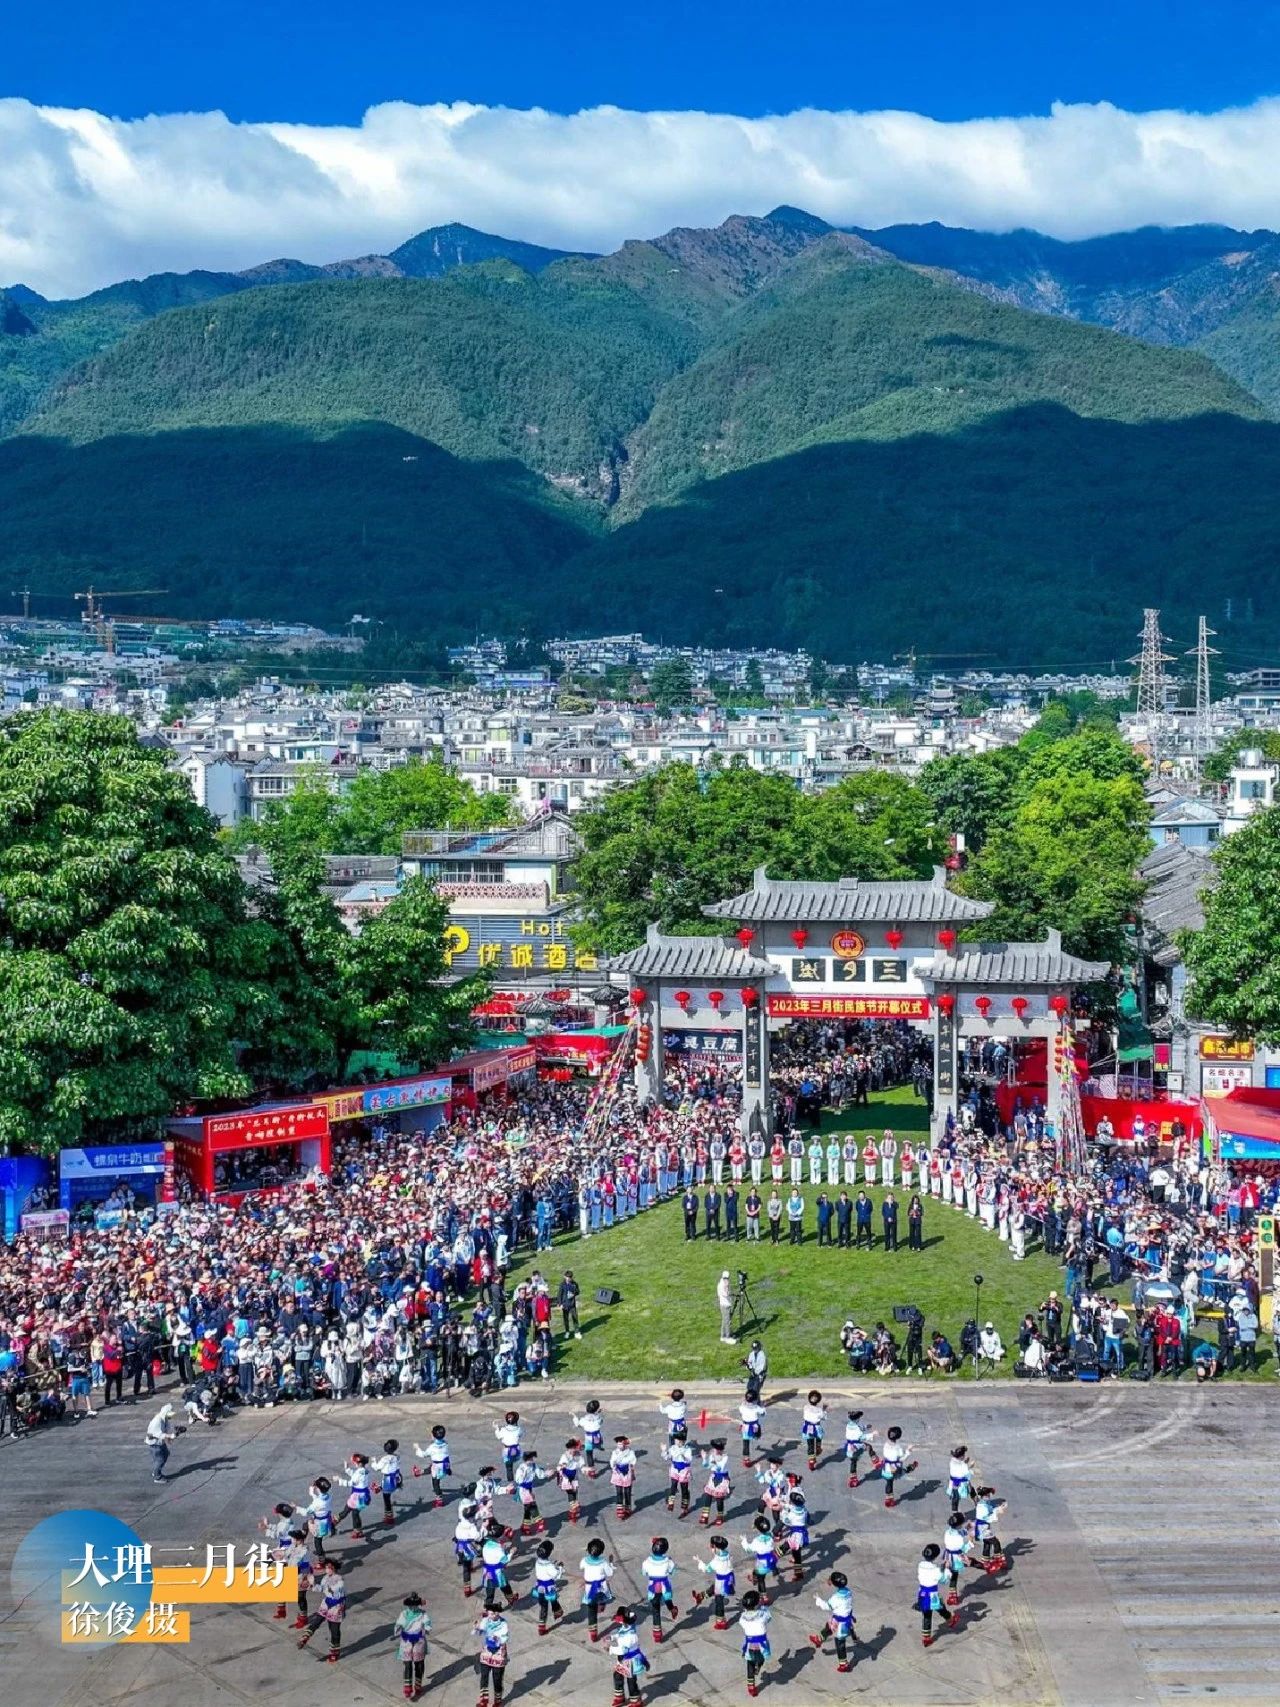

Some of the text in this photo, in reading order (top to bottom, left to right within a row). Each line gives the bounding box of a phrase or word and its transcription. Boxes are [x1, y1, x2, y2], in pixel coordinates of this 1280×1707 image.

[772, 999, 923, 1015] 2023年三月街民族节开幕仪式
